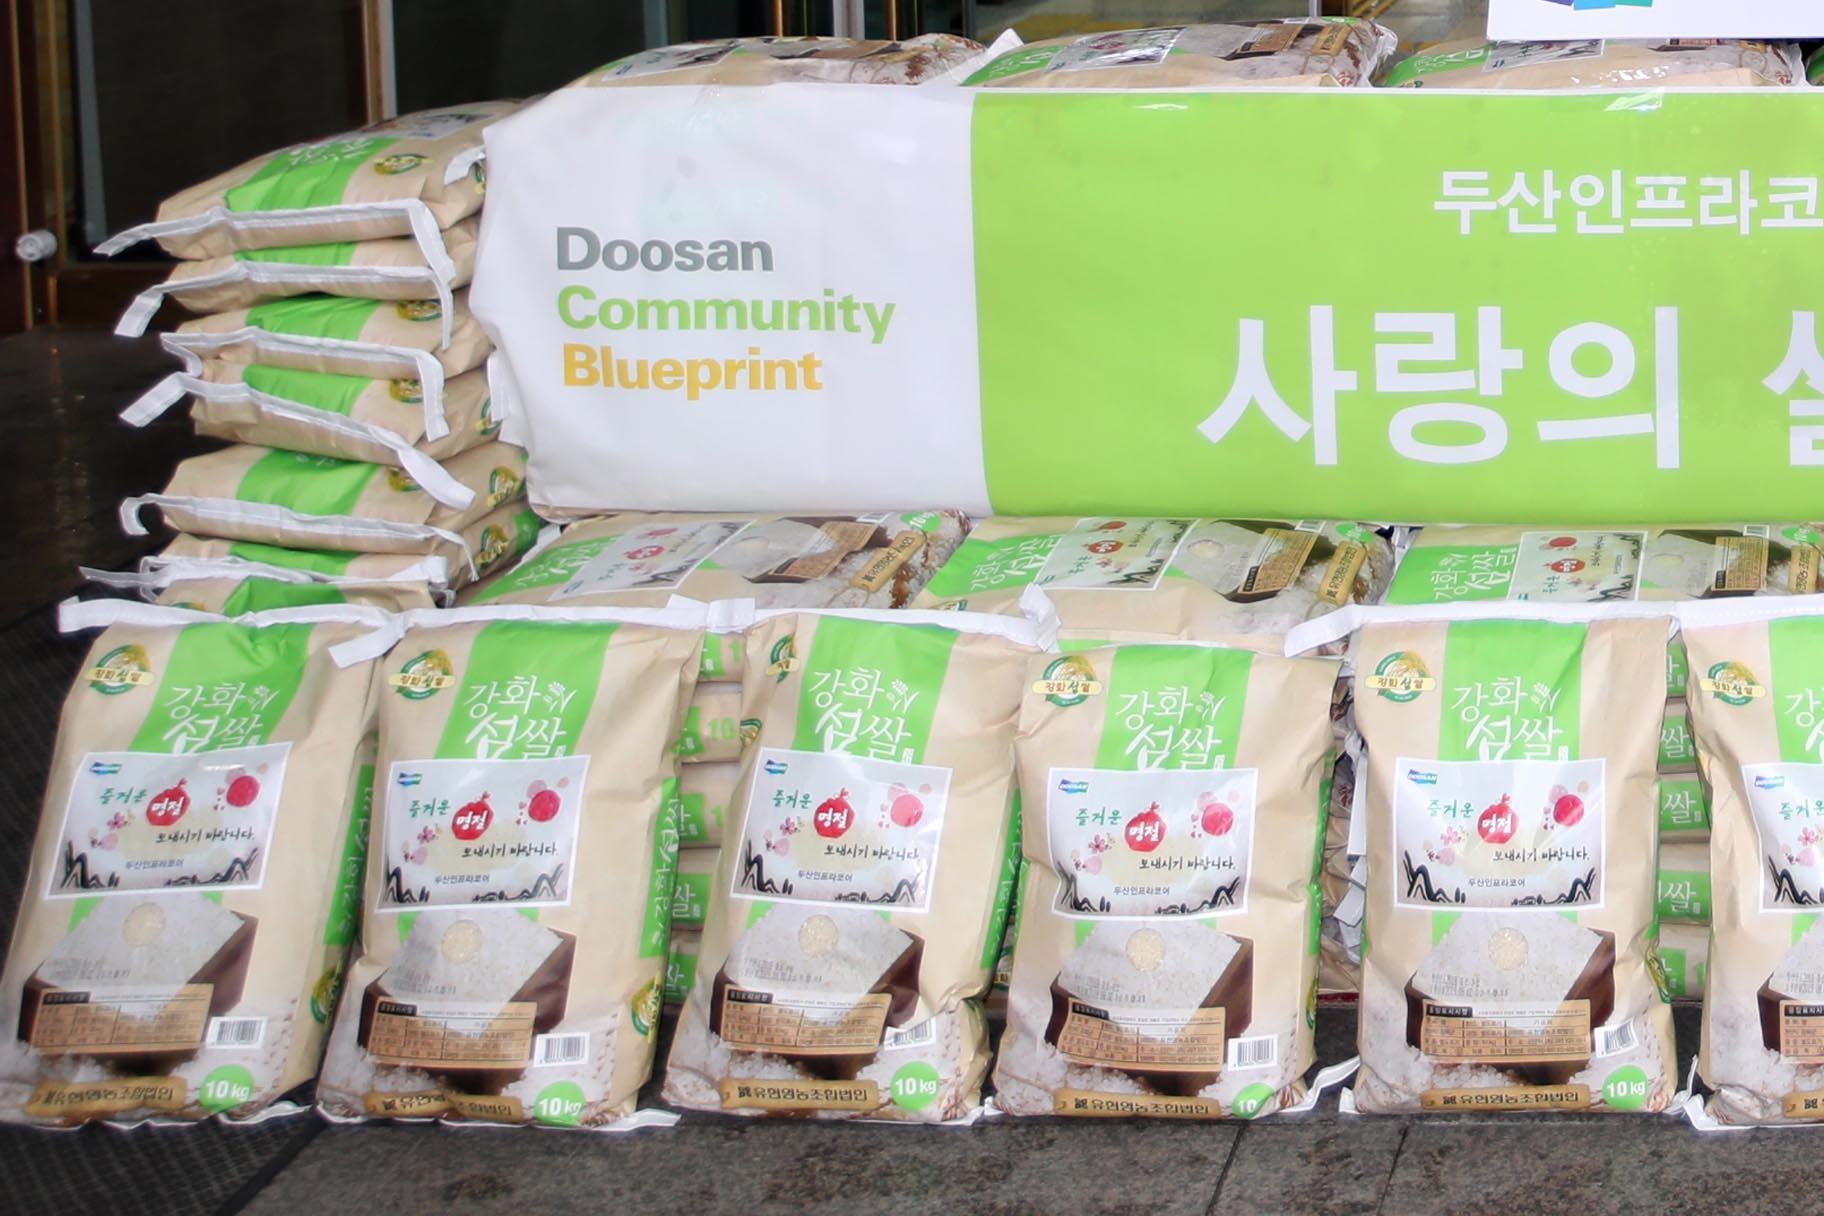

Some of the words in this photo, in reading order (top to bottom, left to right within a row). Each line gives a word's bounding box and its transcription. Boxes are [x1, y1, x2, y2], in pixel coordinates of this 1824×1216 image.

[556, 227, 774, 272] Doosan
[557, 285, 896, 344] Community
[563, 344, 824, 400] Blueprint
[1197, 304, 1680, 469] 사랑의
[164, 683, 247, 719] 강화
[464, 675, 542, 719] 강화
[808, 667, 885, 709] 강화
[1115, 686, 1193, 730] 강화
[1451, 676, 1527, 722] 강화
[409, 798, 450, 818] 즐거운
[456, 810, 488, 831] 명절
[772, 789, 812, 810] 즐거운
[818, 809, 848, 829] 명절
[1075, 807, 1122, 826] 즐거운
[1129, 822, 1160, 842] 명절
[1427, 799, 1473, 818] 즐거운
[1481, 813, 1512, 834] 명절
[462, 844, 505, 858] 보내시기
[824, 844, 868, 858] 보내시기
[1139, 856, 1183, 870] 보내시기
[1493, 848, 1537, 862] 보내시기
